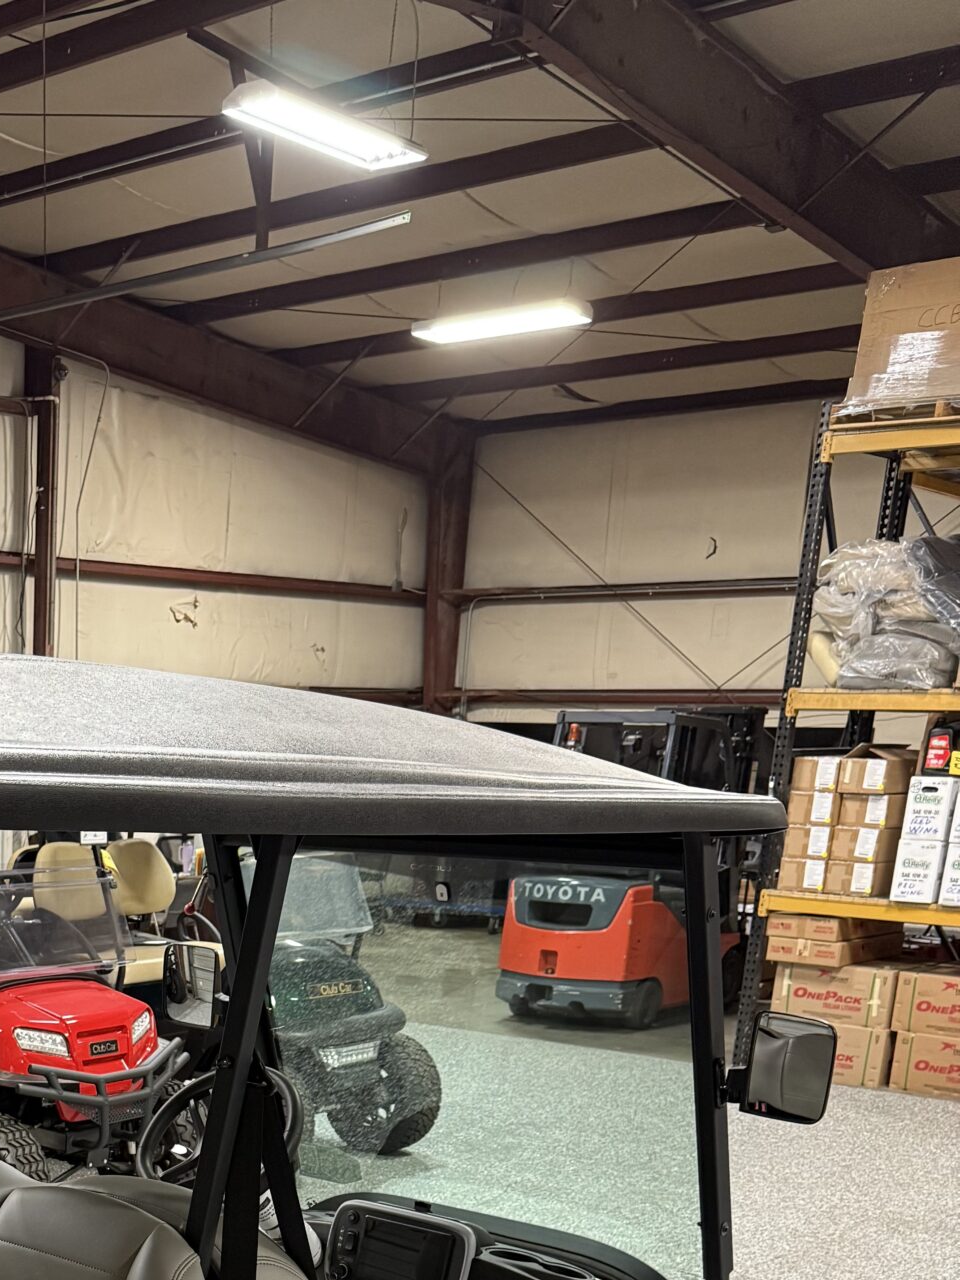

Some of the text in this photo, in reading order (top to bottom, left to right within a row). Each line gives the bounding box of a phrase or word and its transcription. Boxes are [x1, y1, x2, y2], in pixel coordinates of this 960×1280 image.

[524, 882, 606, 903] TOYOTA
[320, 982, 352, 995] Club Car
[92, 1043, 106, 1054] Club
